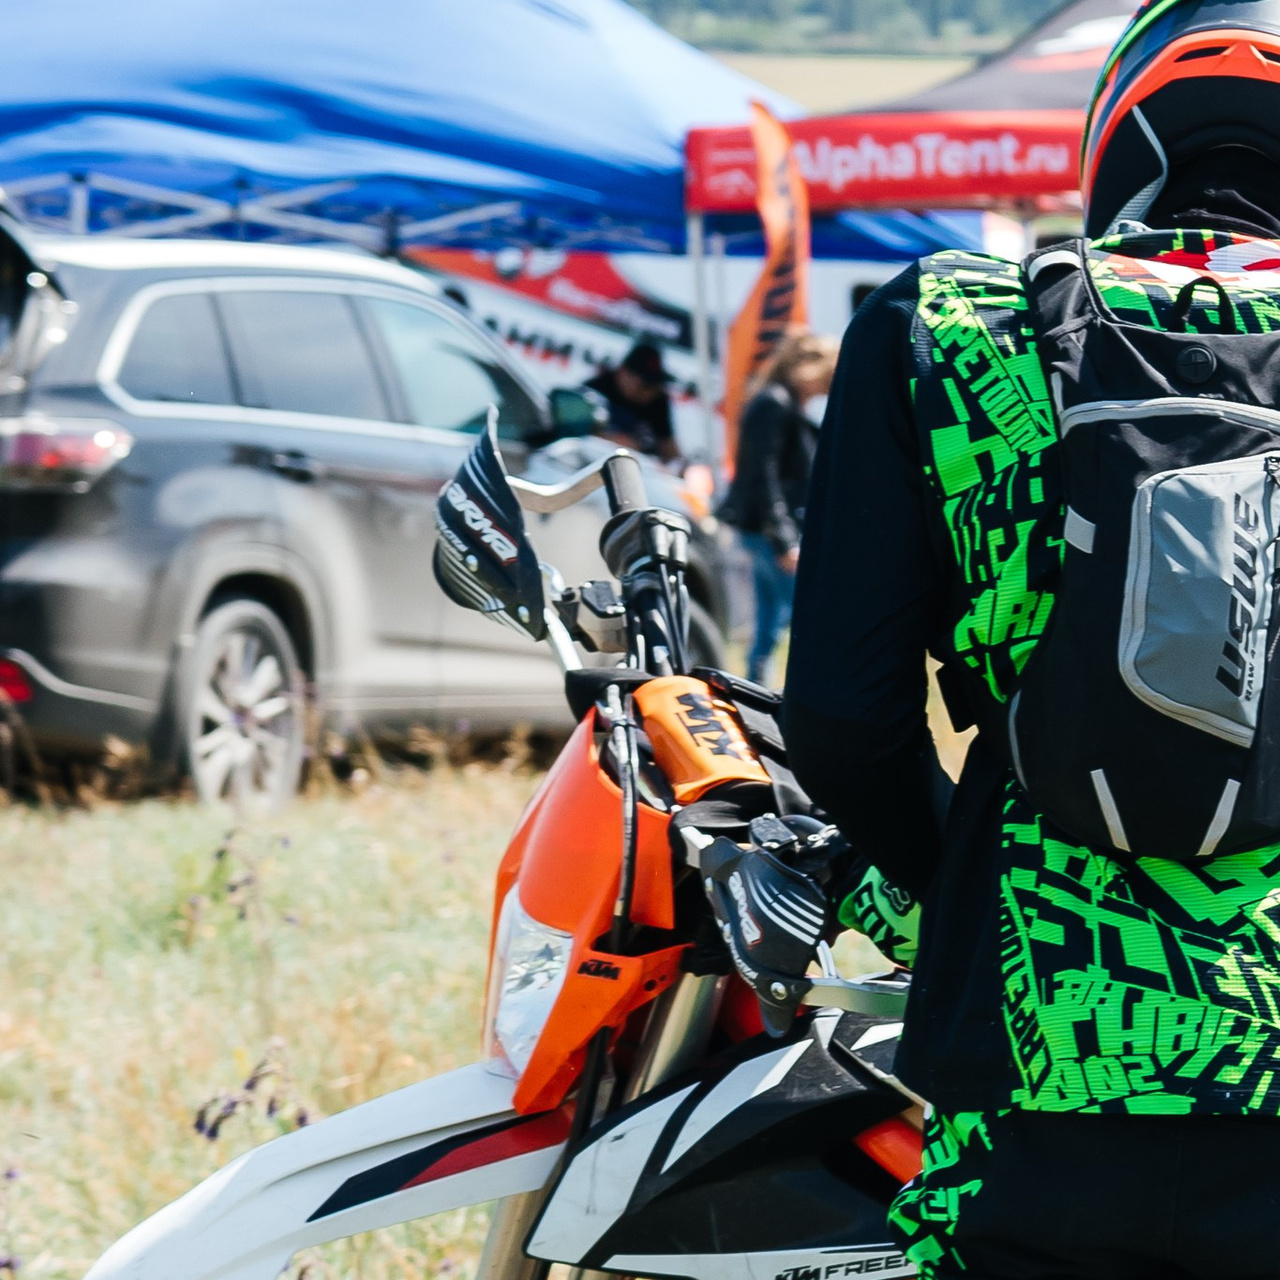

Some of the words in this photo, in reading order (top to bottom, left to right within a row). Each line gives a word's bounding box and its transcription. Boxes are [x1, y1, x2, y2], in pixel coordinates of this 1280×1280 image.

[1214, 492, 1260, 698] USWE
[675, 692, 744, 762] KTM
[577, 958, 622, 981] KTM
